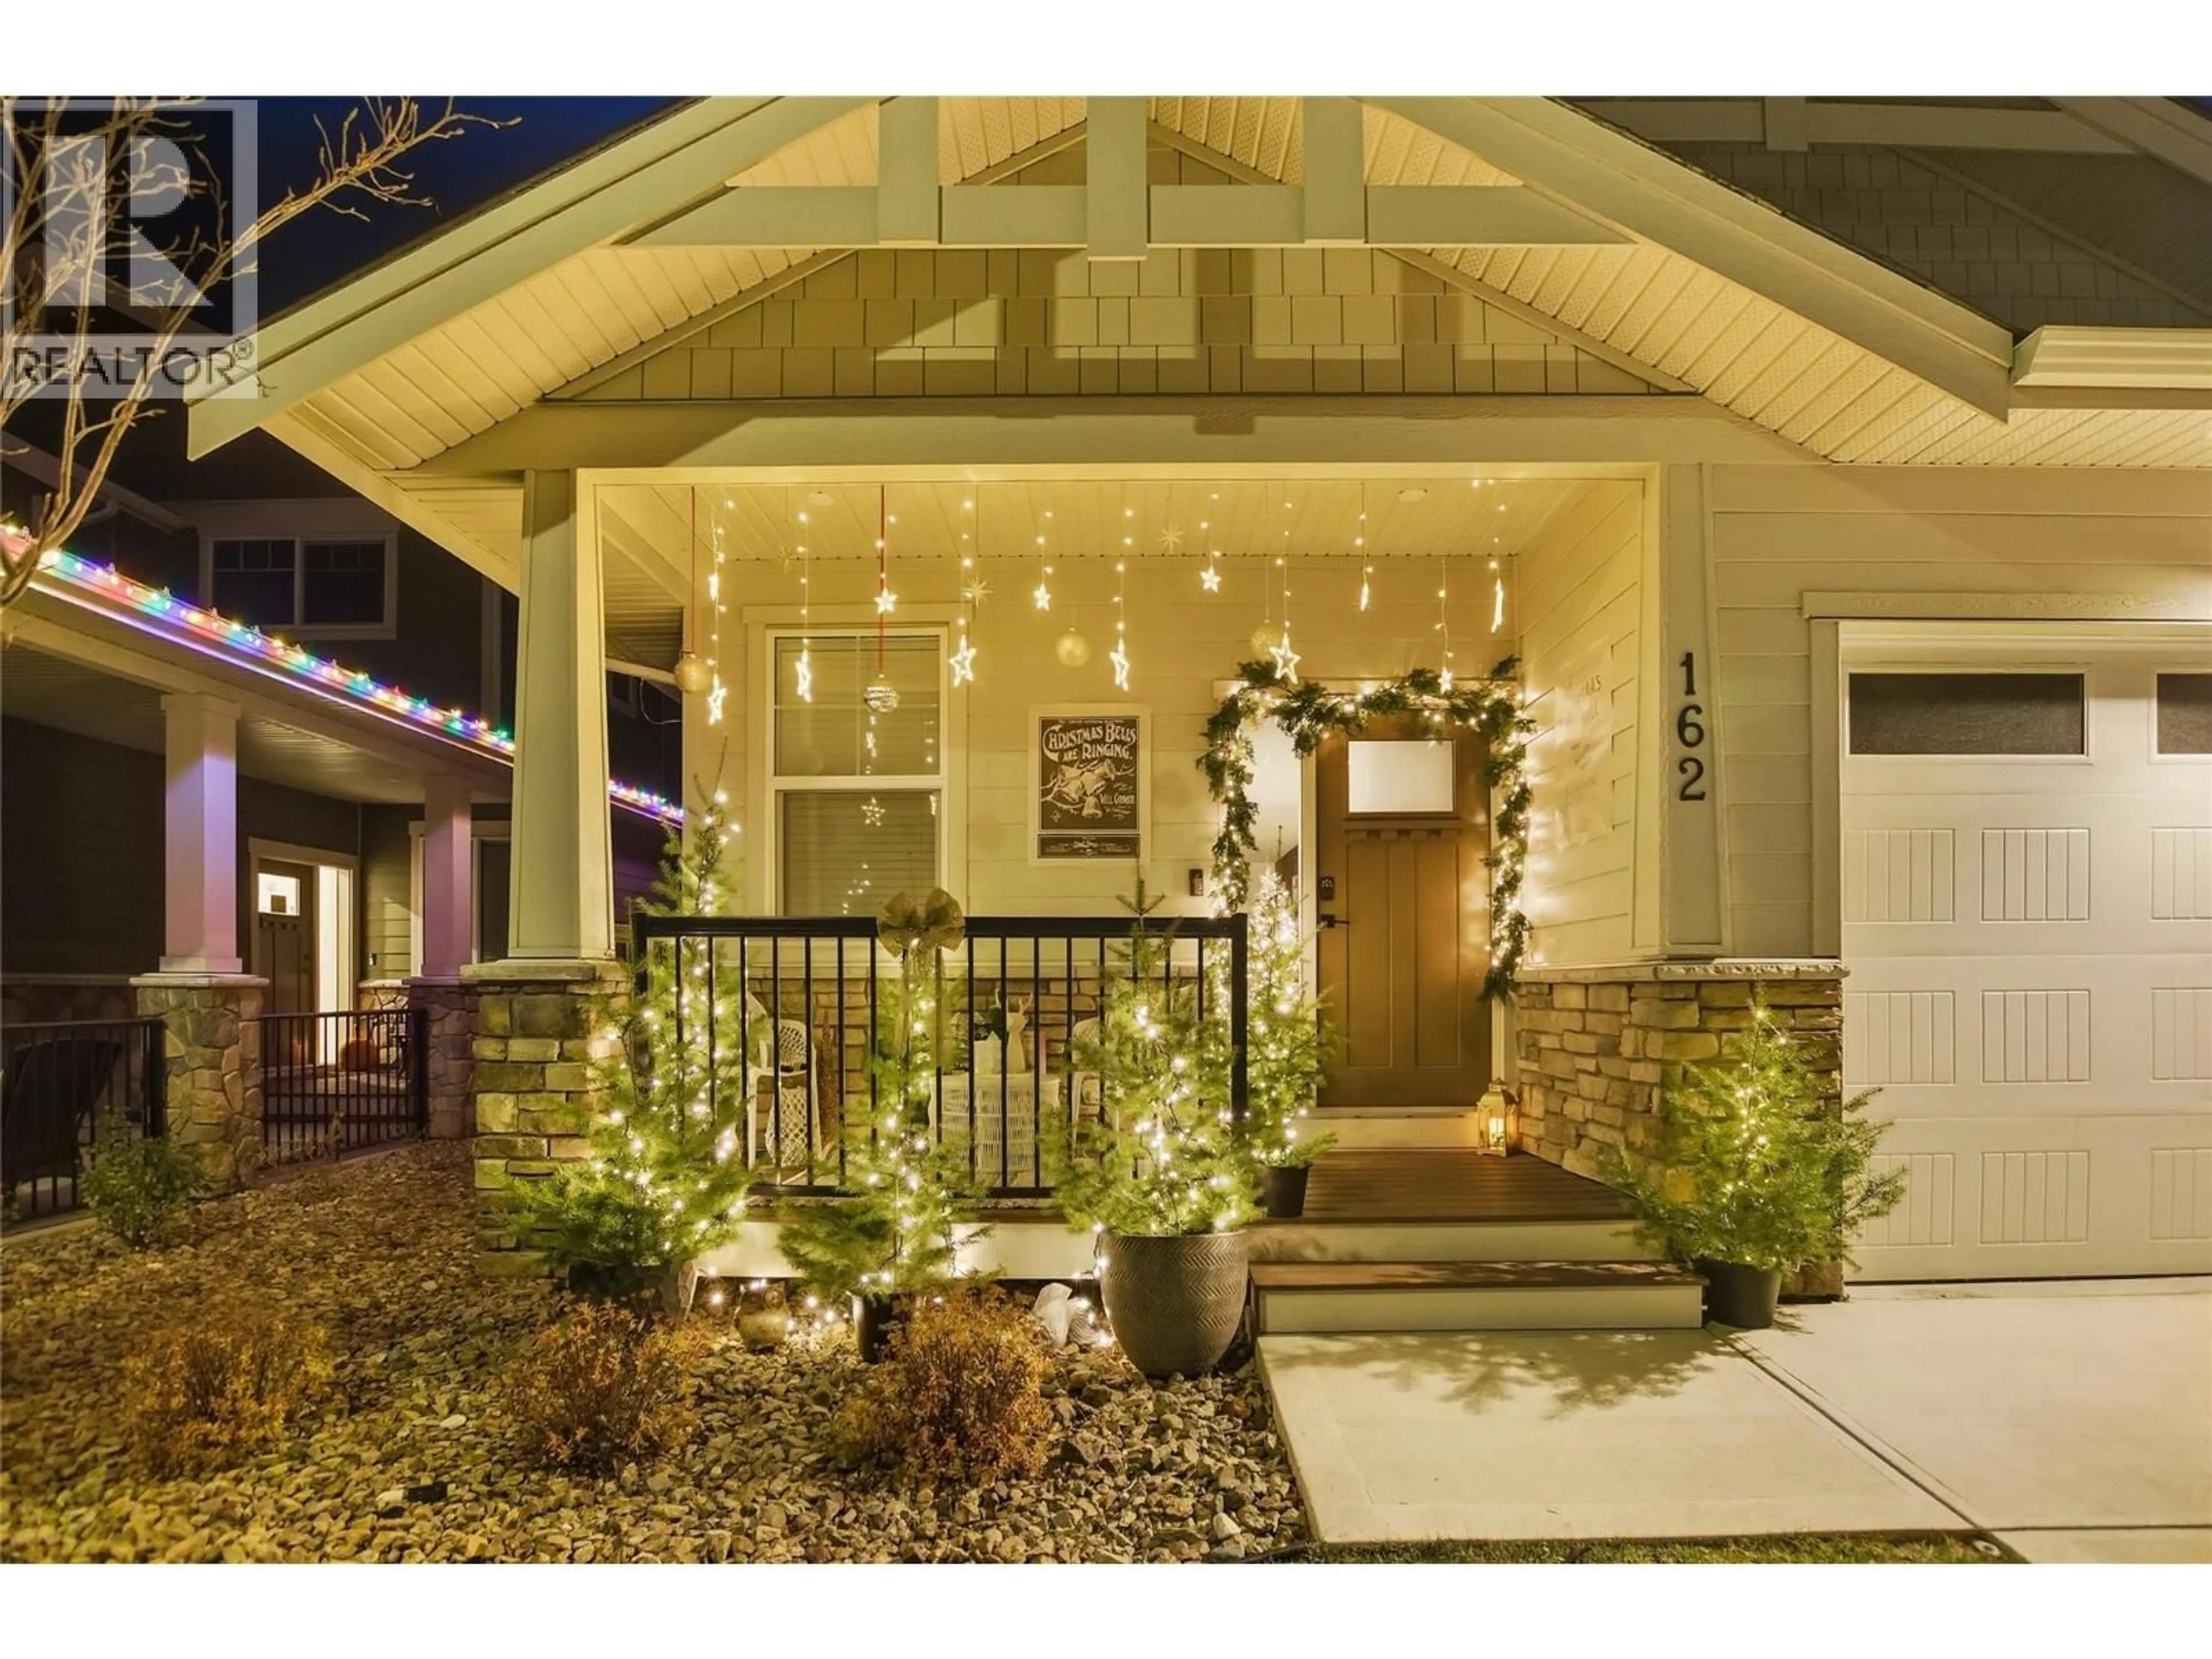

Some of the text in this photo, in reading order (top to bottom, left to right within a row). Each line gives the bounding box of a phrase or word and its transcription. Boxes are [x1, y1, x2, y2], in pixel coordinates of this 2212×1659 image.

[1043, 725, 1103, 762] CHRISTMAS
[1677, 652, 1706, 801] 162
[1063, 749, 1079, 762] ARE
